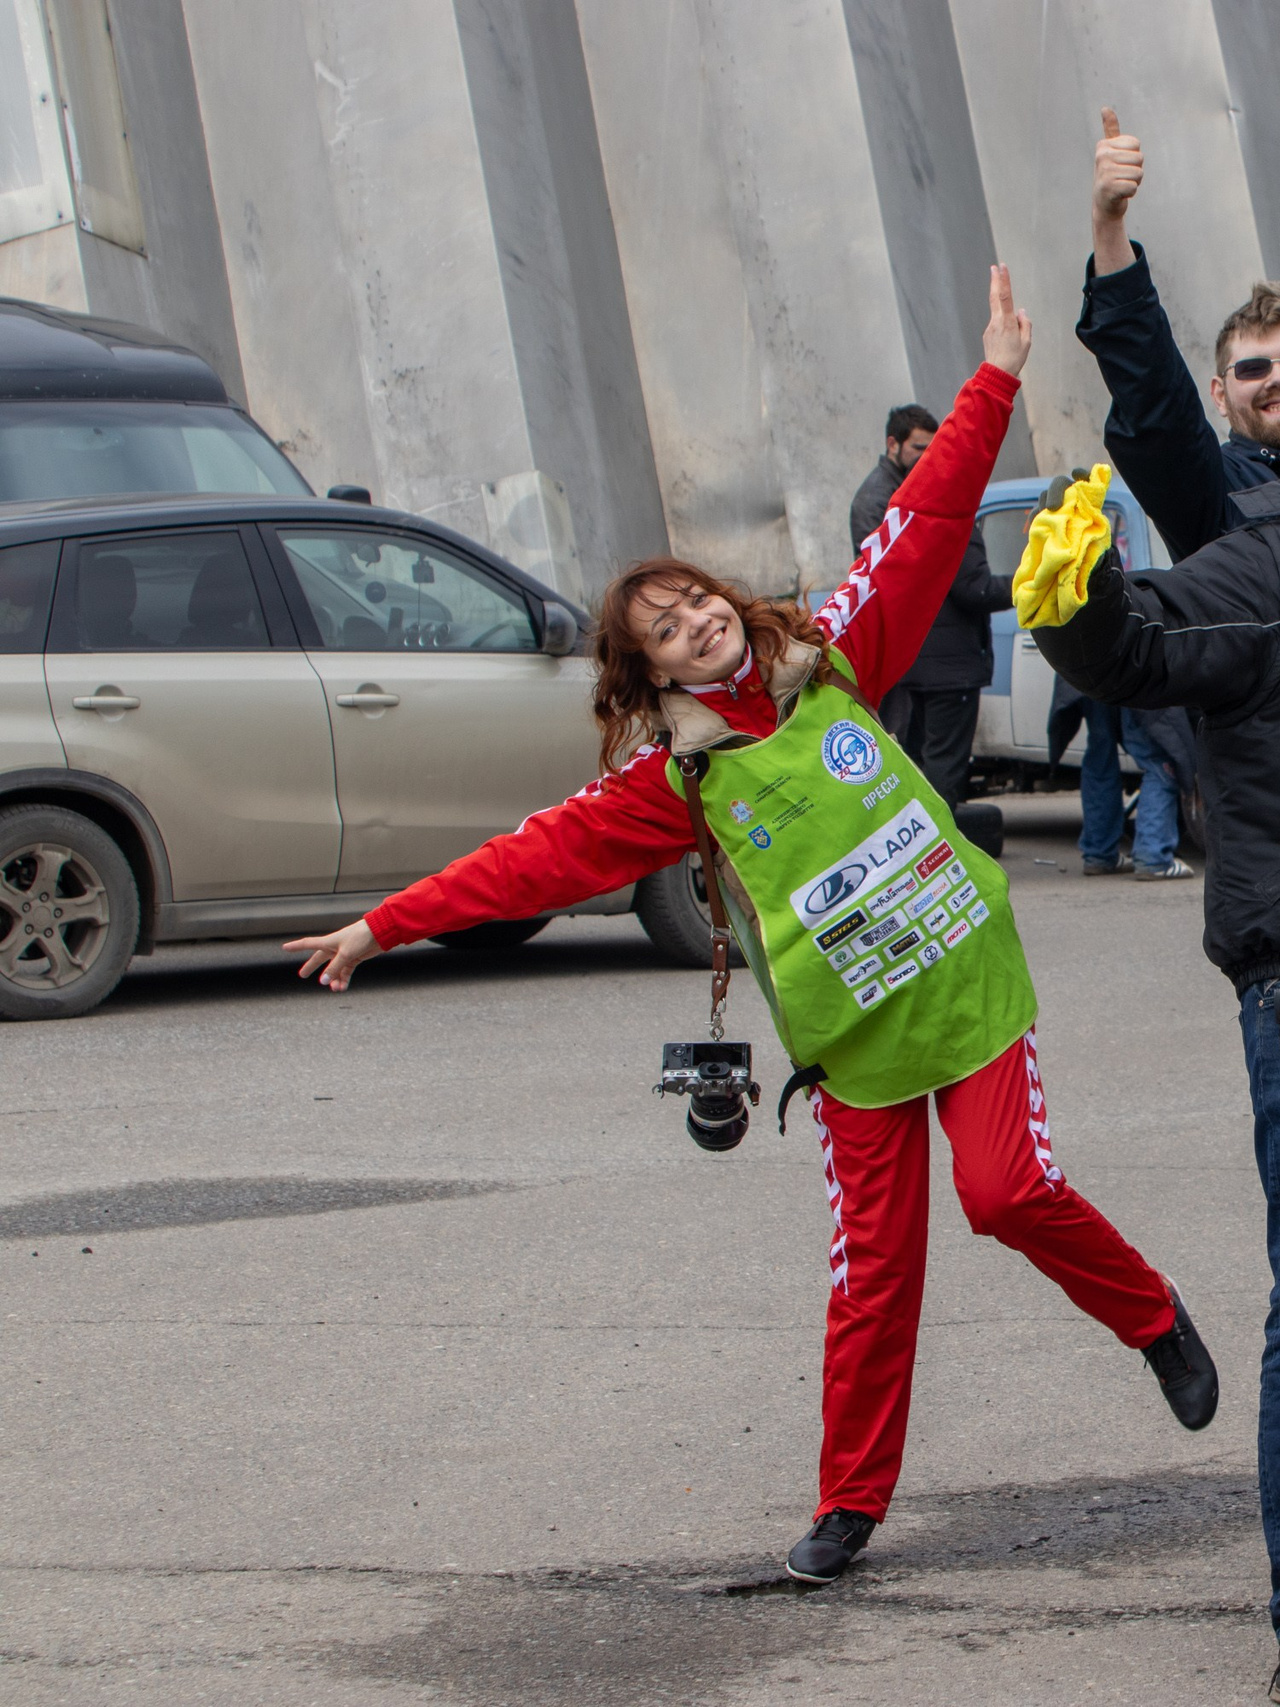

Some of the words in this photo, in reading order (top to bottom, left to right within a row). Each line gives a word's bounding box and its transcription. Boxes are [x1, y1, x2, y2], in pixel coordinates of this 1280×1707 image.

[861, 772, 901, 811] ПРЕССА
[867, 818, 926, 869] LADA
[927, 845, 950, 866] SEGWAY
[831, 917, 859, 939] STELS
